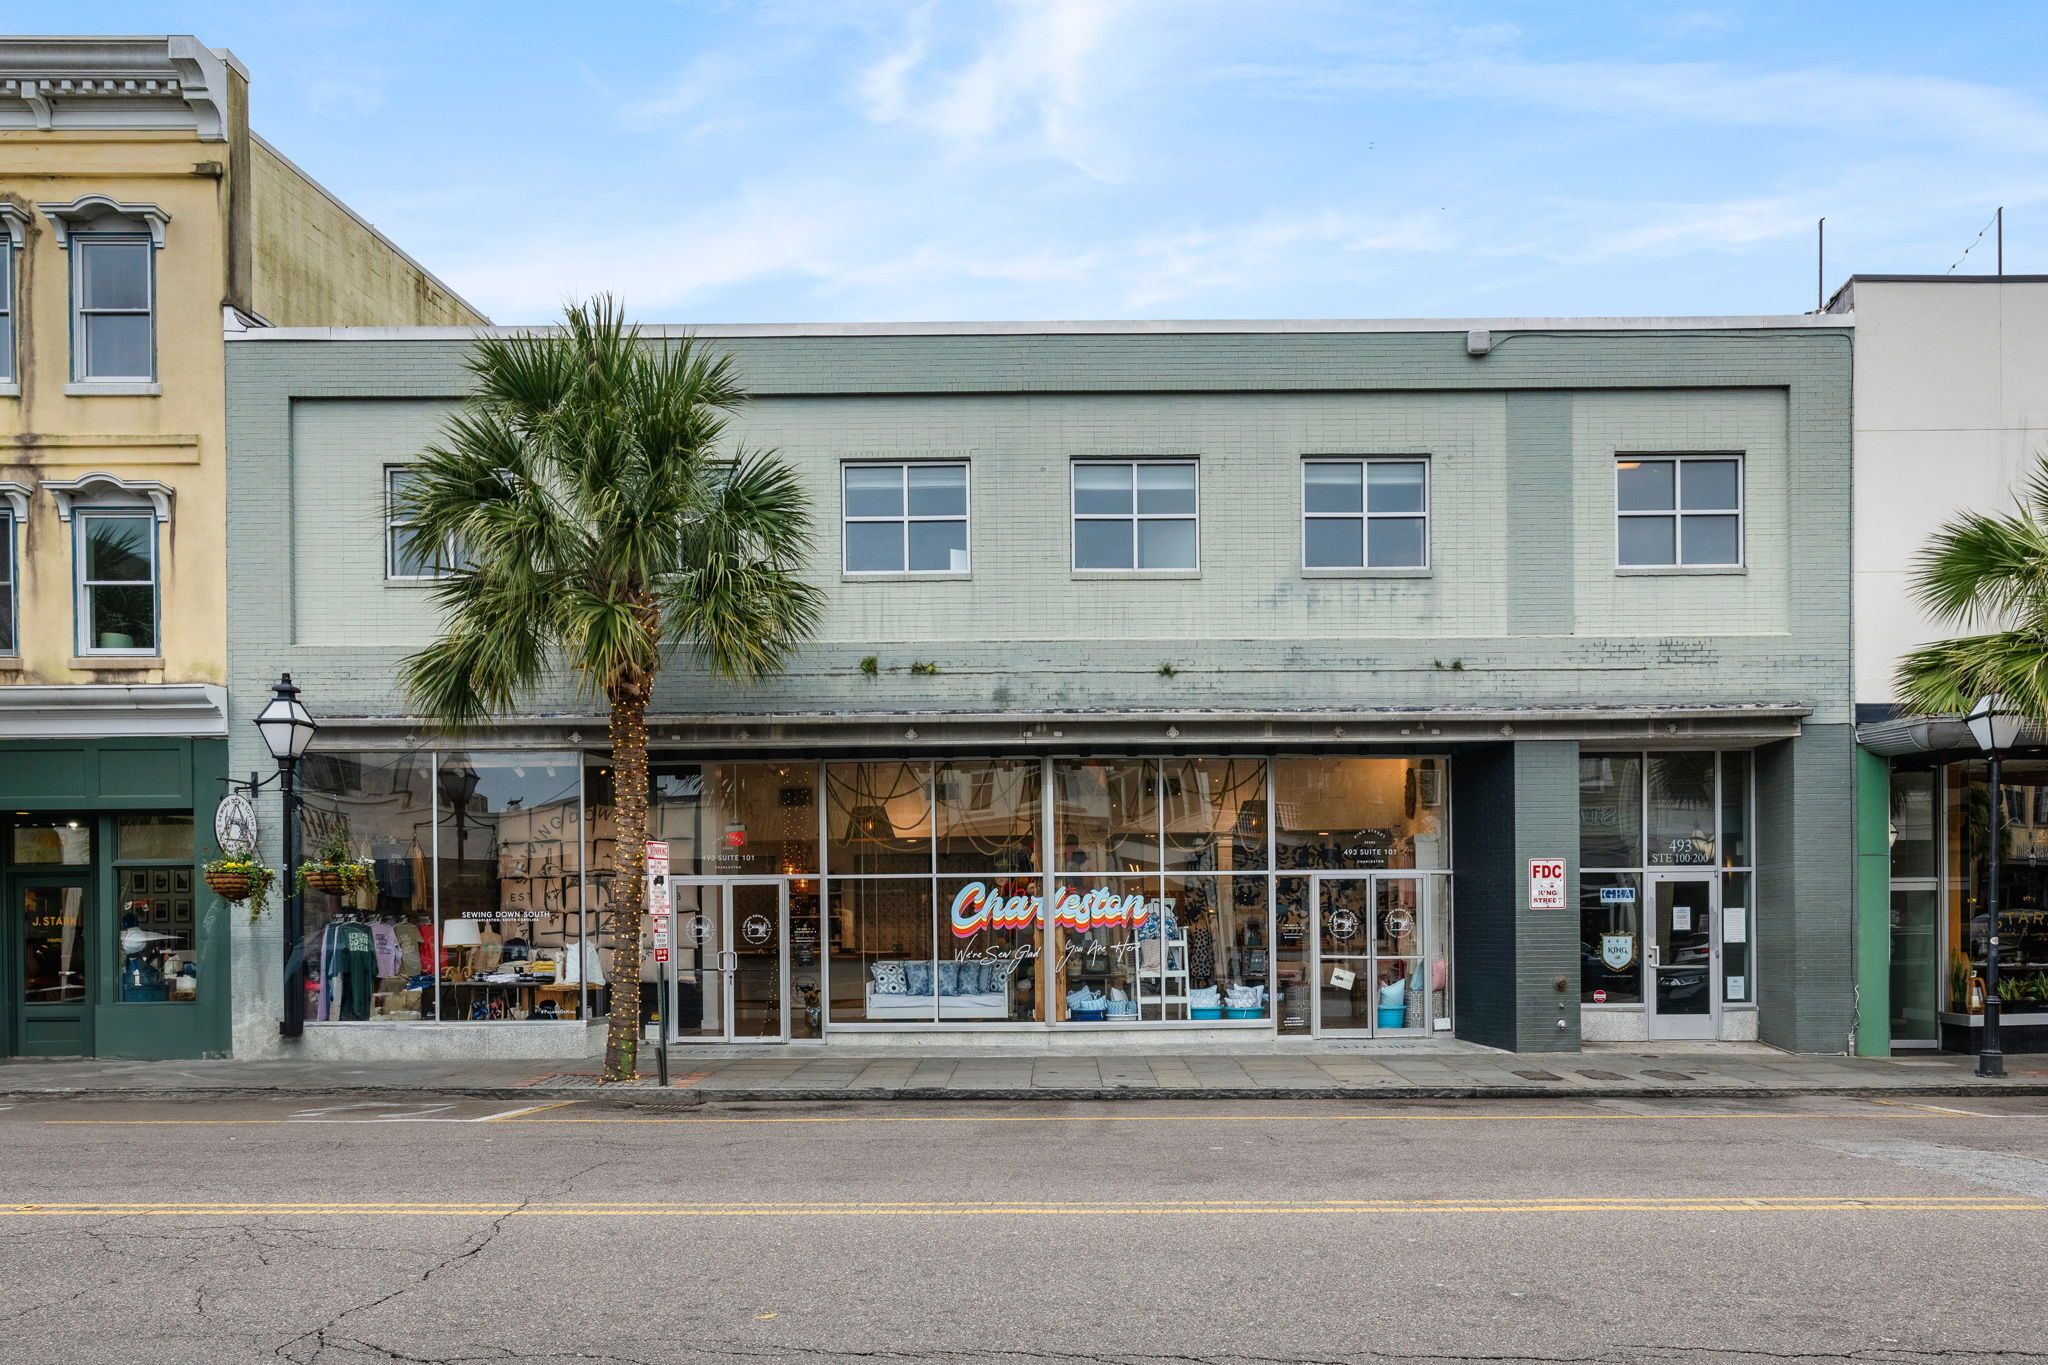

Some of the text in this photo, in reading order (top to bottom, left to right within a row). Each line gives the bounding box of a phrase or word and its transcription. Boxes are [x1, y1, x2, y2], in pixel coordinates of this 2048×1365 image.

[1669, 838, 1692, 852] 493
[1652, 854, 1672, 862] STE
[1532, 864, 1562, 878] FDC
[1603, 889, 1632, 899] GBA
[951, 881, 1148, 938] Charleston
[32, 916, 41, 926] J.
[1998, 911, 2048, 928] TAR
[954, 934, 1140, 974] We're Sew Glad You Are Here
[1608, 946, 1630, 954] KING
